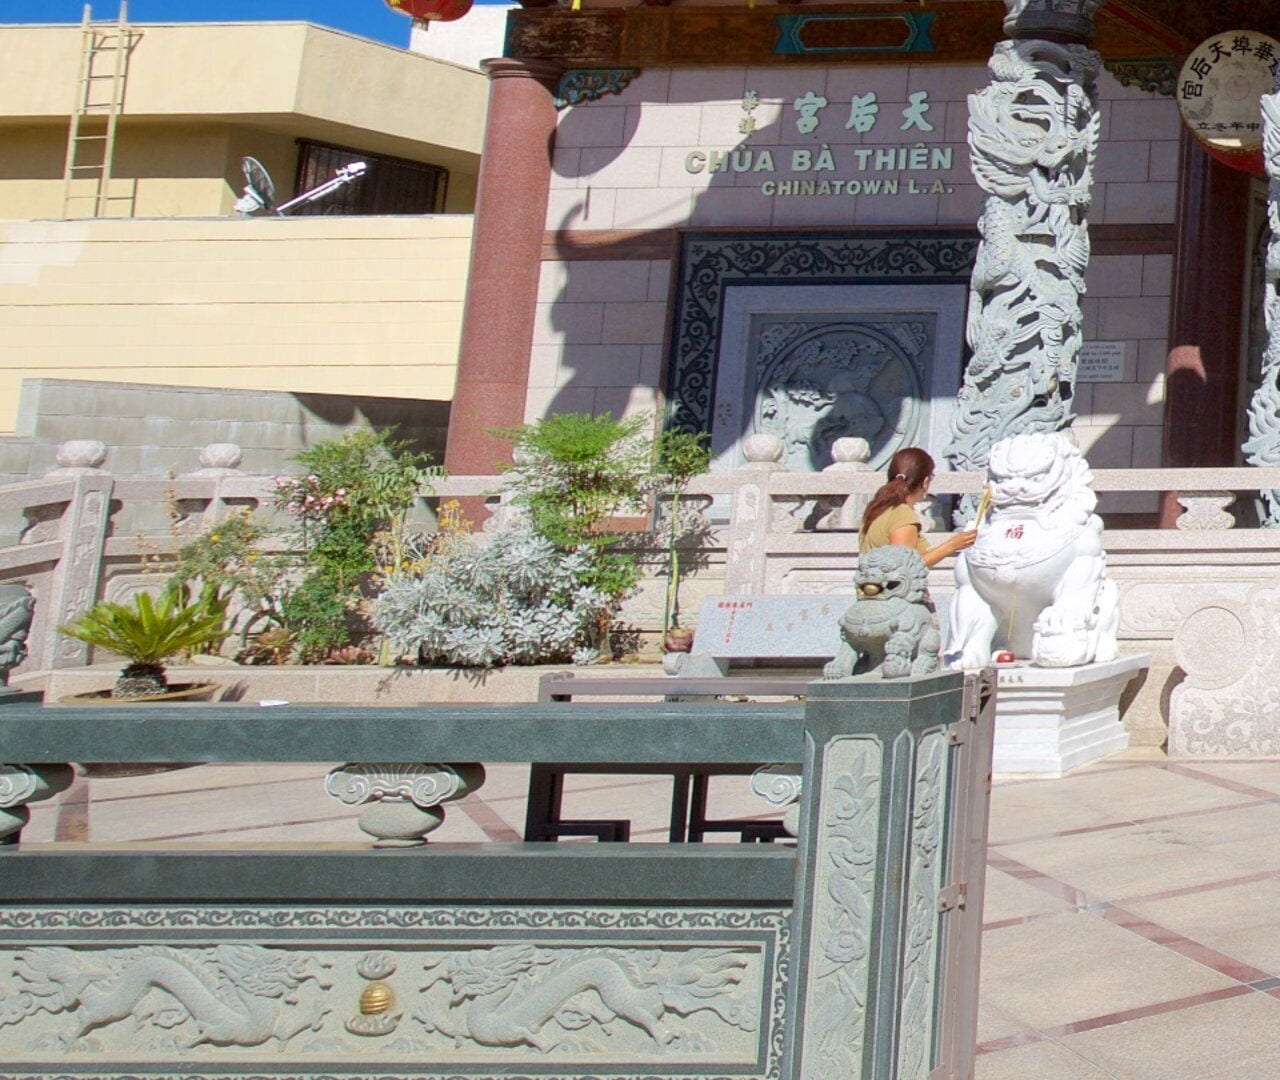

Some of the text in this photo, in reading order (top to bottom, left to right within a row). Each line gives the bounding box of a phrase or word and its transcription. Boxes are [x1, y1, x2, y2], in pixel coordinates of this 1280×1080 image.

[794, 91, 935, 134] 天后宮
[685, 142, 953, 174] CHÙA BÀ THIÊN
[762, 178, 954, 197] CHINATOWN L.A.
